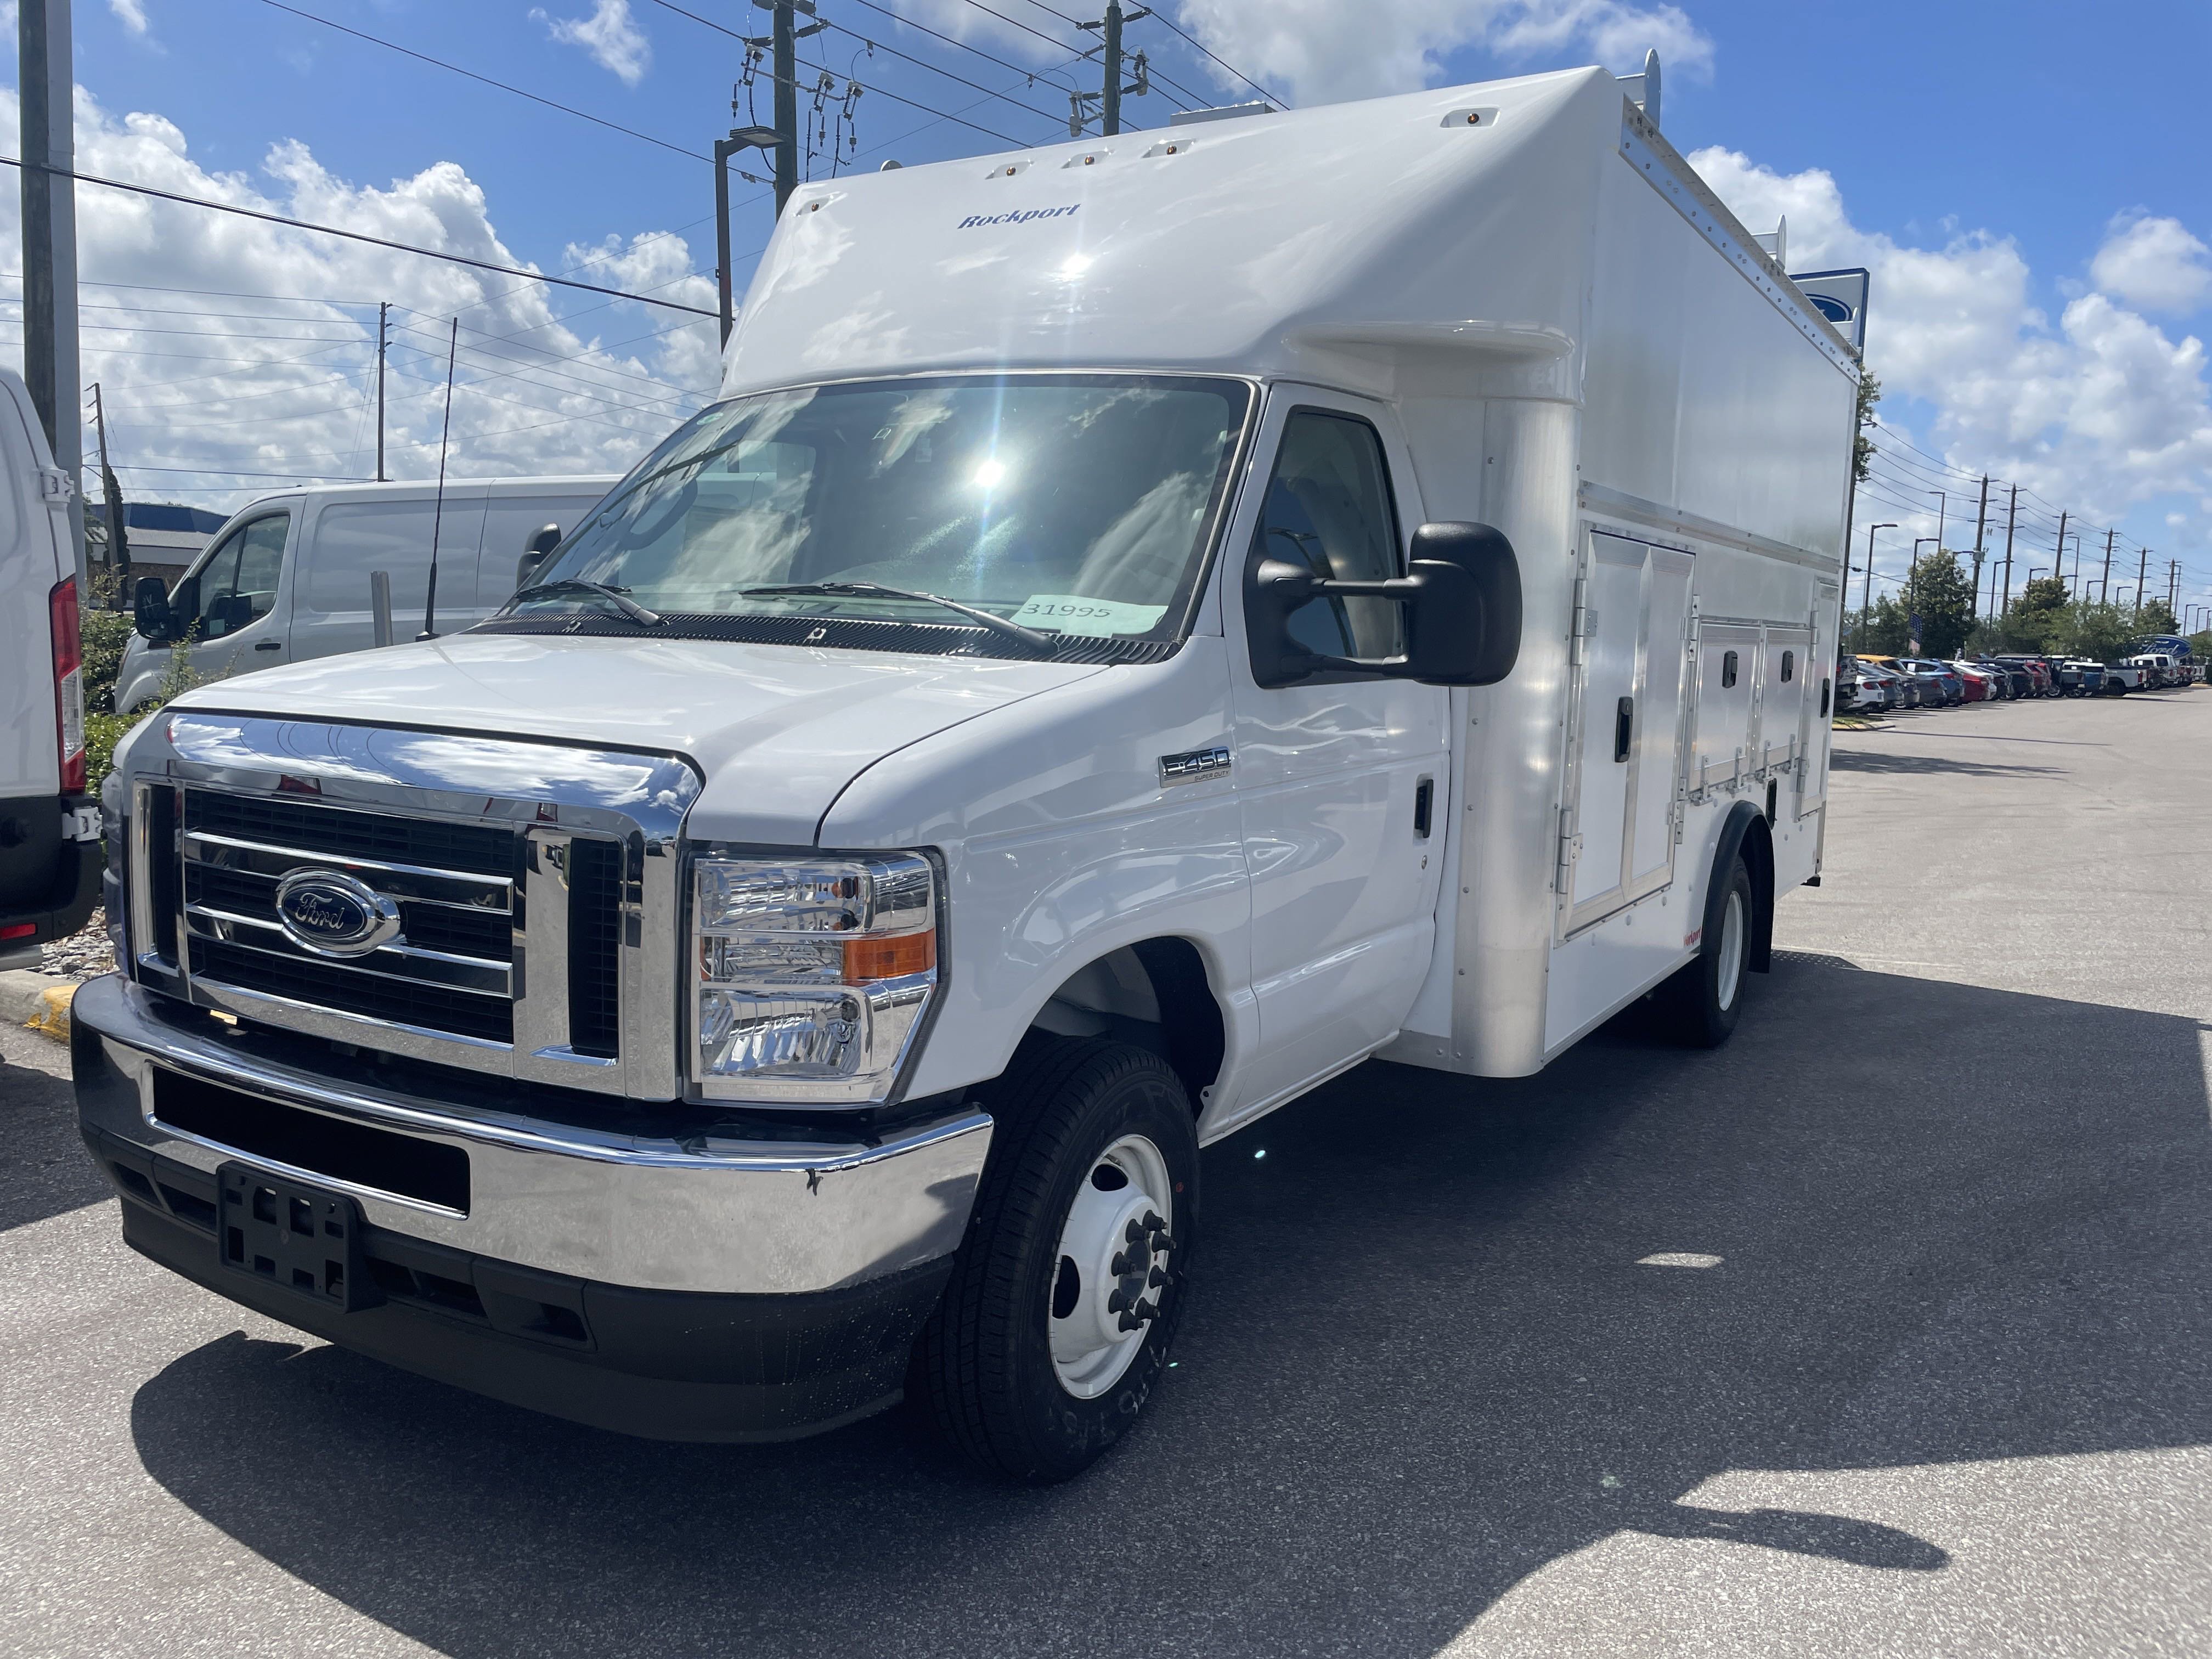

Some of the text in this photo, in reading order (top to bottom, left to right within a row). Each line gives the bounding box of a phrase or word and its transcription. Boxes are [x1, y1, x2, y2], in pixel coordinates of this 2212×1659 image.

[957, 203, 1081, 229] Rockport
[1022, 603, 1113, 618] 31995
[1194, 772, 1214, 781] SUPER
[295, 892, 345, 930] Ford
